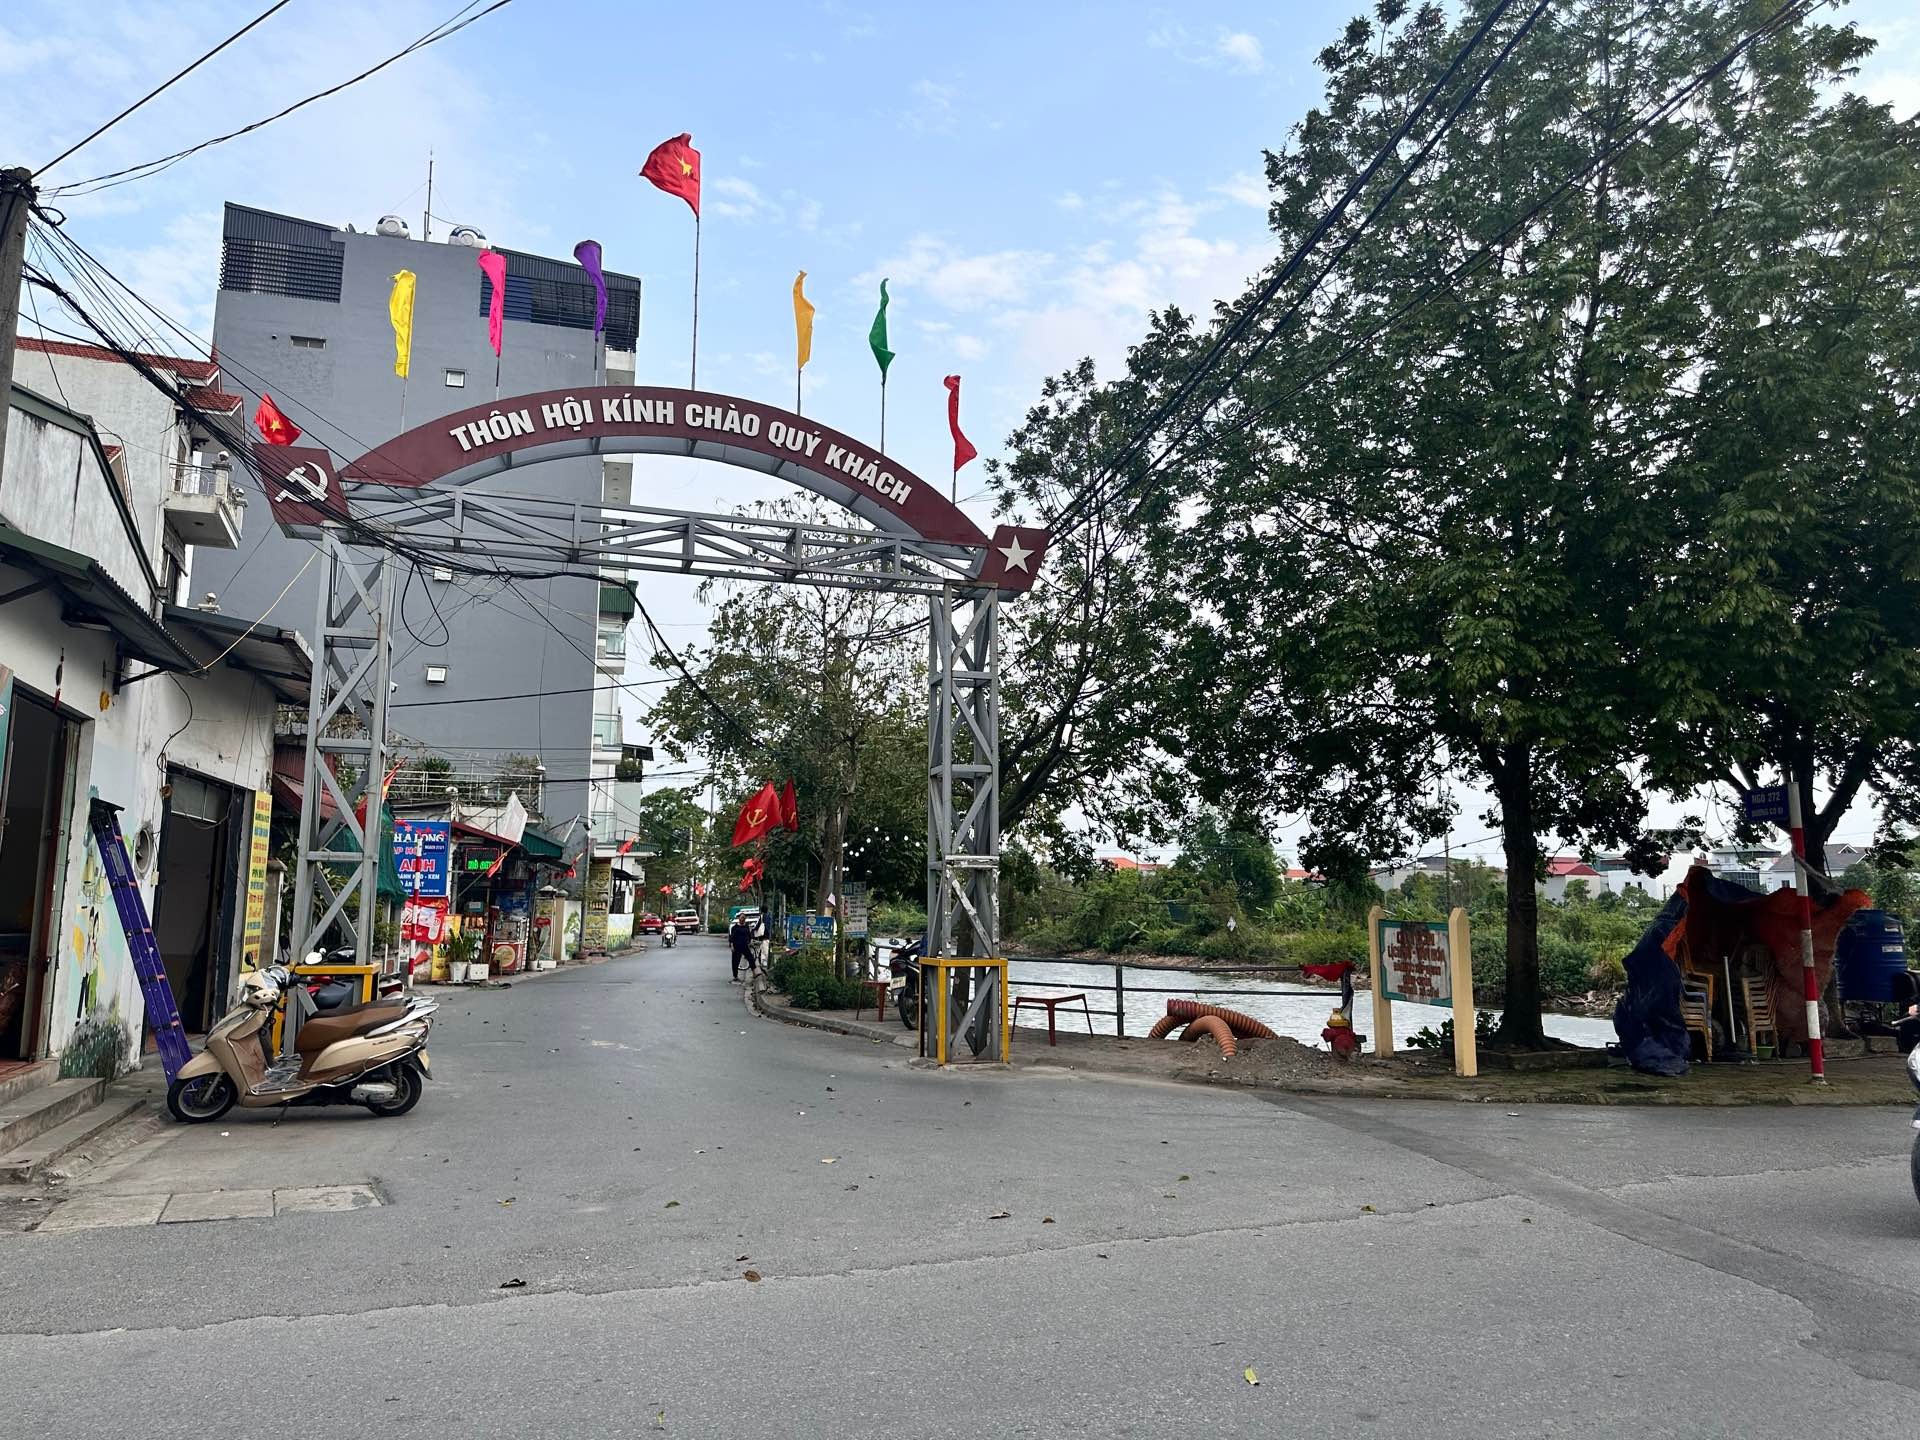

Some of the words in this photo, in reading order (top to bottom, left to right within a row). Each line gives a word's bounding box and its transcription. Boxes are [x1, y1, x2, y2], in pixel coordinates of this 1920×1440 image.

[449, 409, 536, 452] THÔN
[542, 397, 594, 433] HỘI
[602, 392, 675, 425] KÍNH
[685, 402, 761, 437] CHÀO
[767, 421, 822, 459] QUÝ
[826, 445, 912, 505] KHÁCH
[1767, 791, 1781, 802] 272
